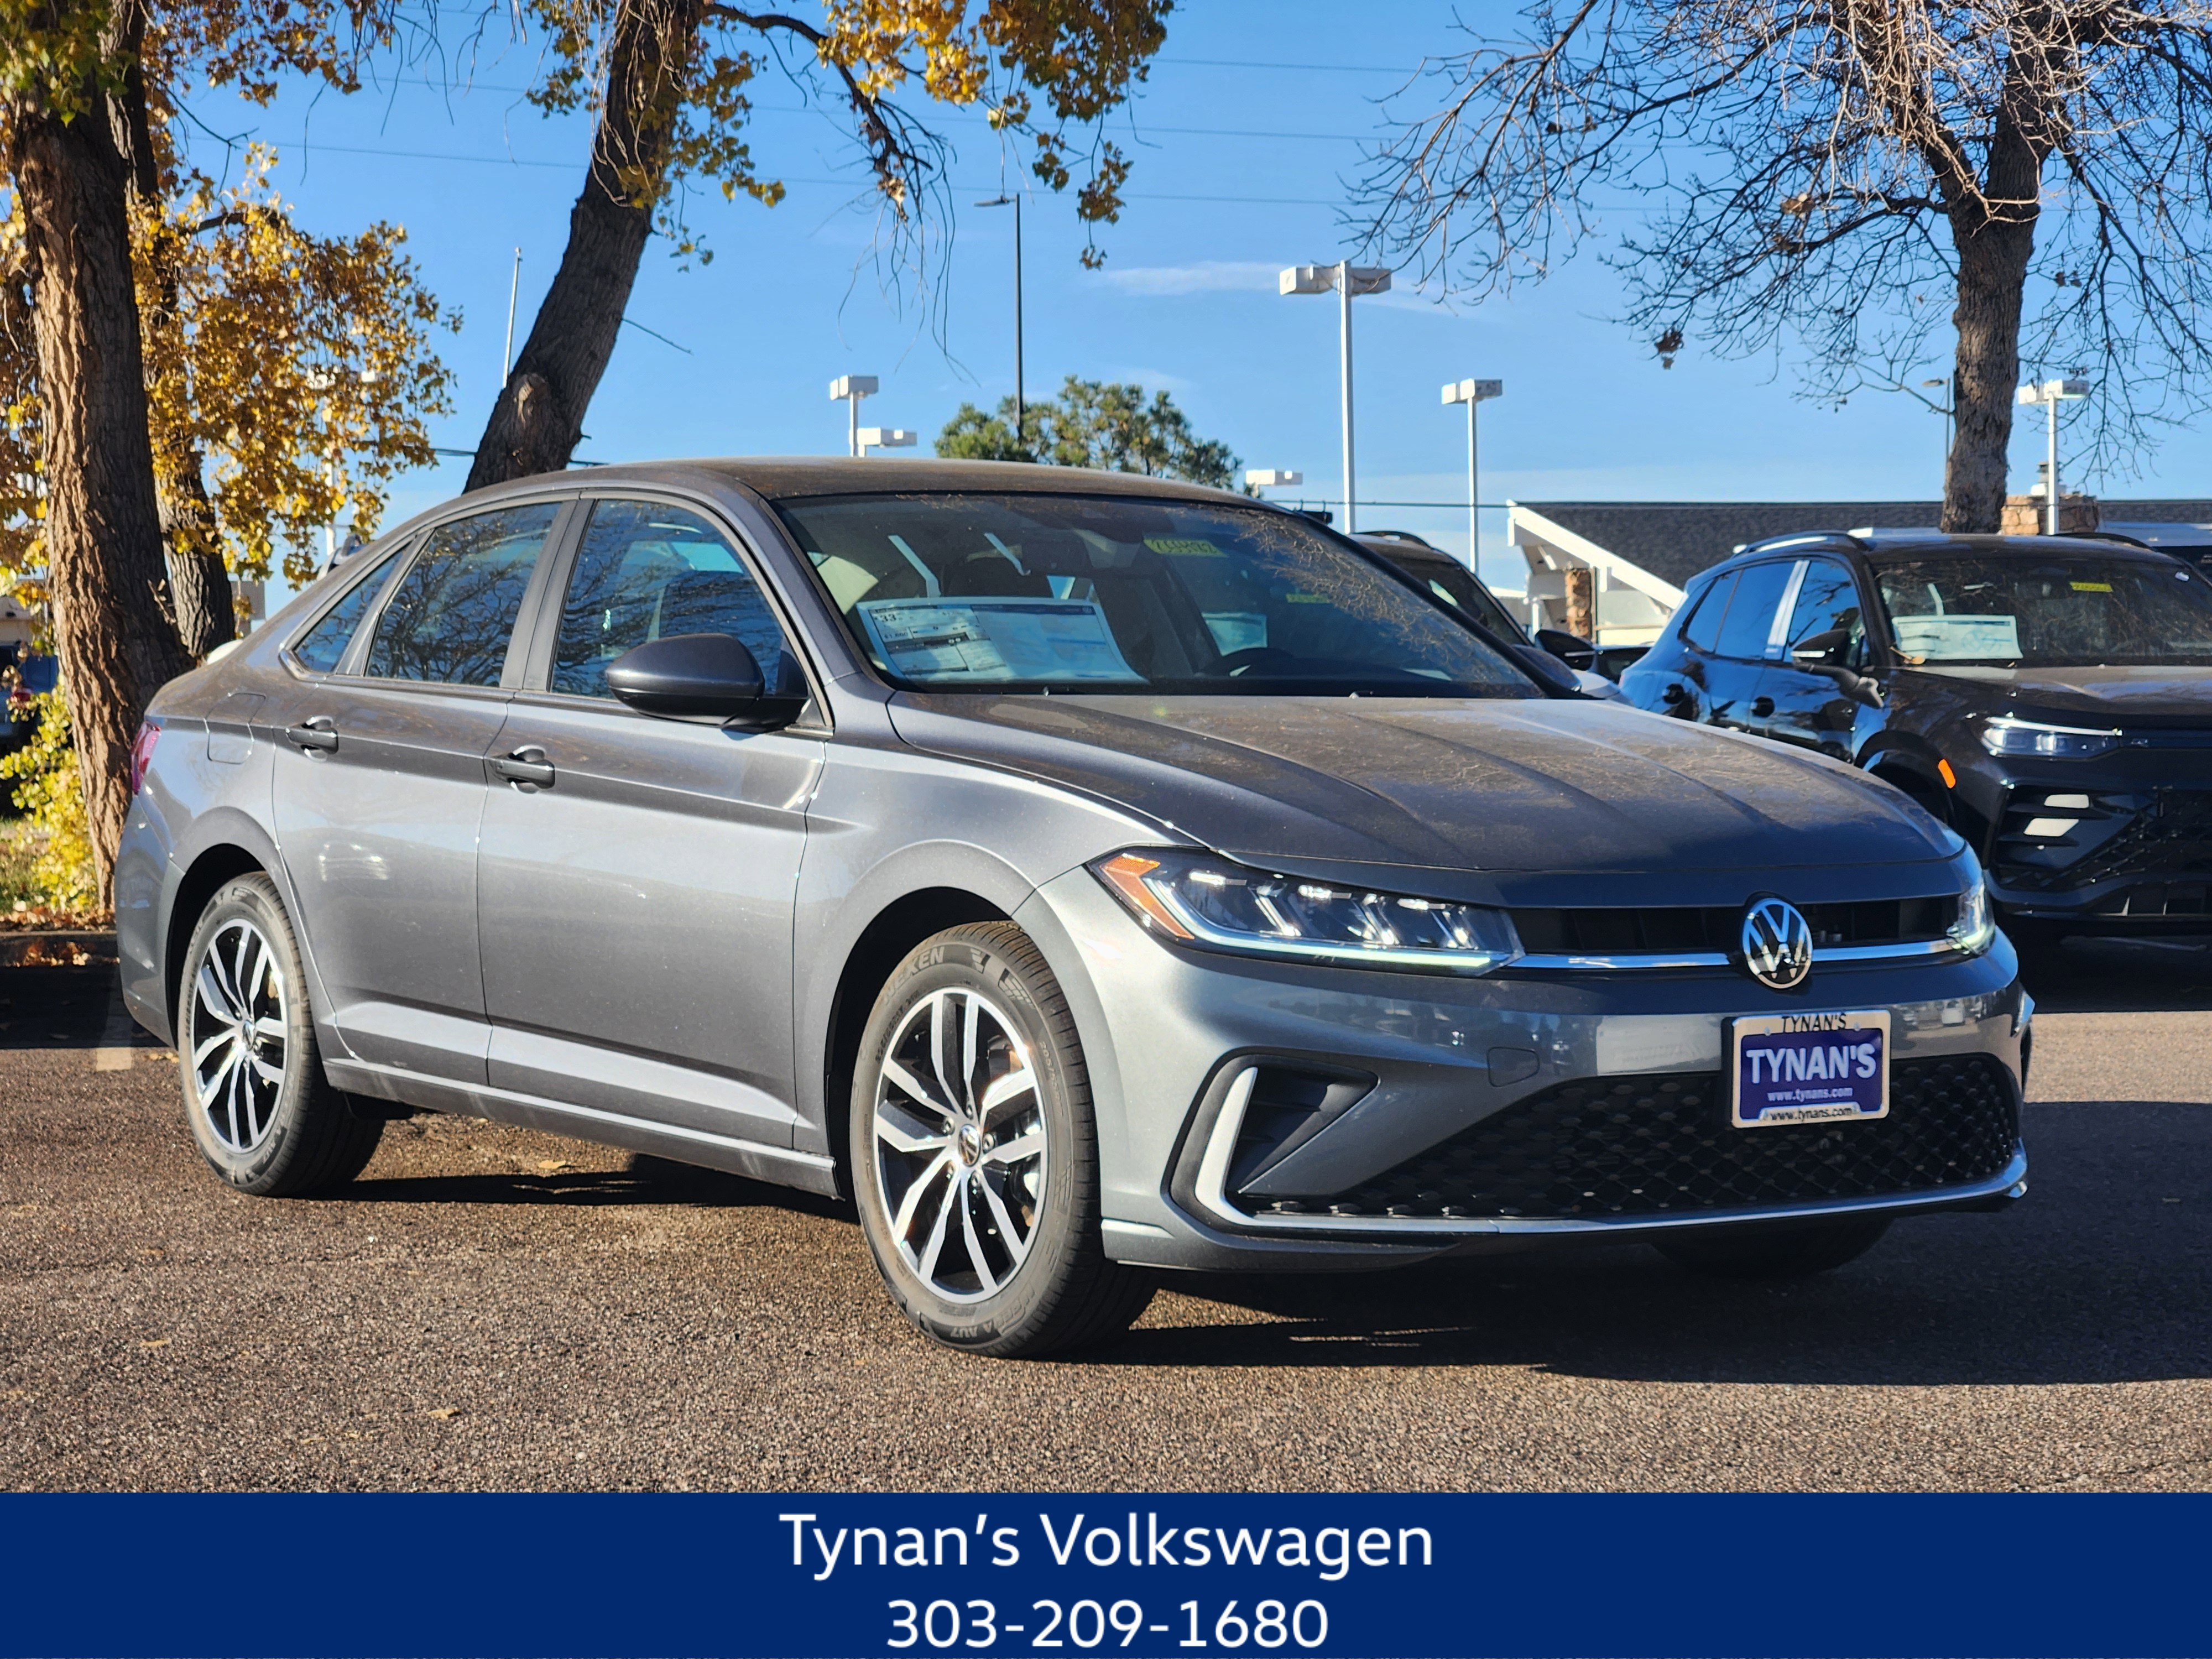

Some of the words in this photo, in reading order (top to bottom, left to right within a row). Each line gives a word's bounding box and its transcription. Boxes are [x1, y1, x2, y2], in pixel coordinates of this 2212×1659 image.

[1781, 1011, 1846, 1032] TYNAN'S
[1746, 1043, 1877, 1084] TYNAN'S
[1767, 1087, 1853, 1103] www.tynans.com
[1770, 1108, 1853, 1124] www.tynans.com
